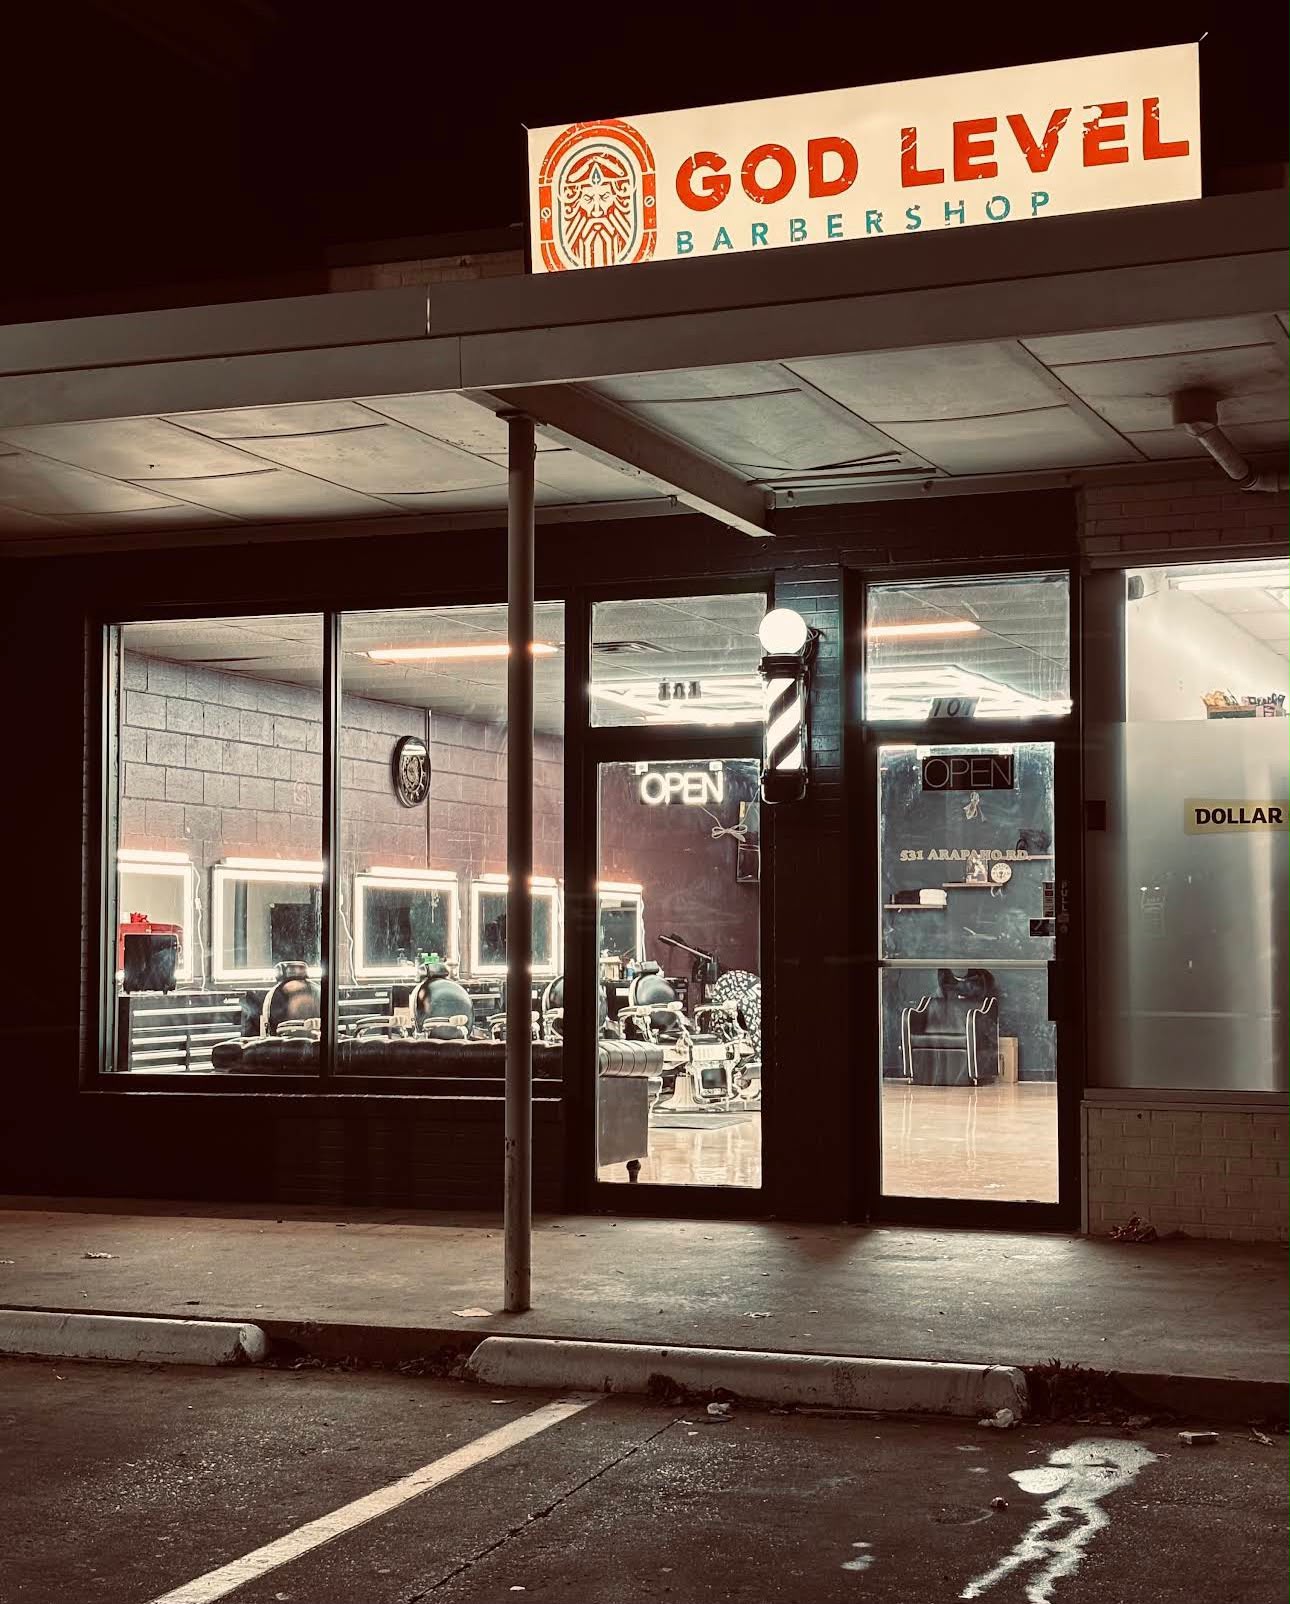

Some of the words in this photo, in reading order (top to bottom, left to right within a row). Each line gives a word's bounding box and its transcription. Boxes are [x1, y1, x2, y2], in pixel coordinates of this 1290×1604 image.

[675, 136, 859, 212] GOD
[901, 97, 1190, 188] LEVEL
[676, 191, 1053, 256] BARBERSHOP
[659, 681, 699, 698] 101
[640, 771, 723, 803] OPEN
[924, 758, 1012, 788] OPEN
[1195, 807, 1283, 825] DOLLAR
[900, 850, 924, 861] 531
